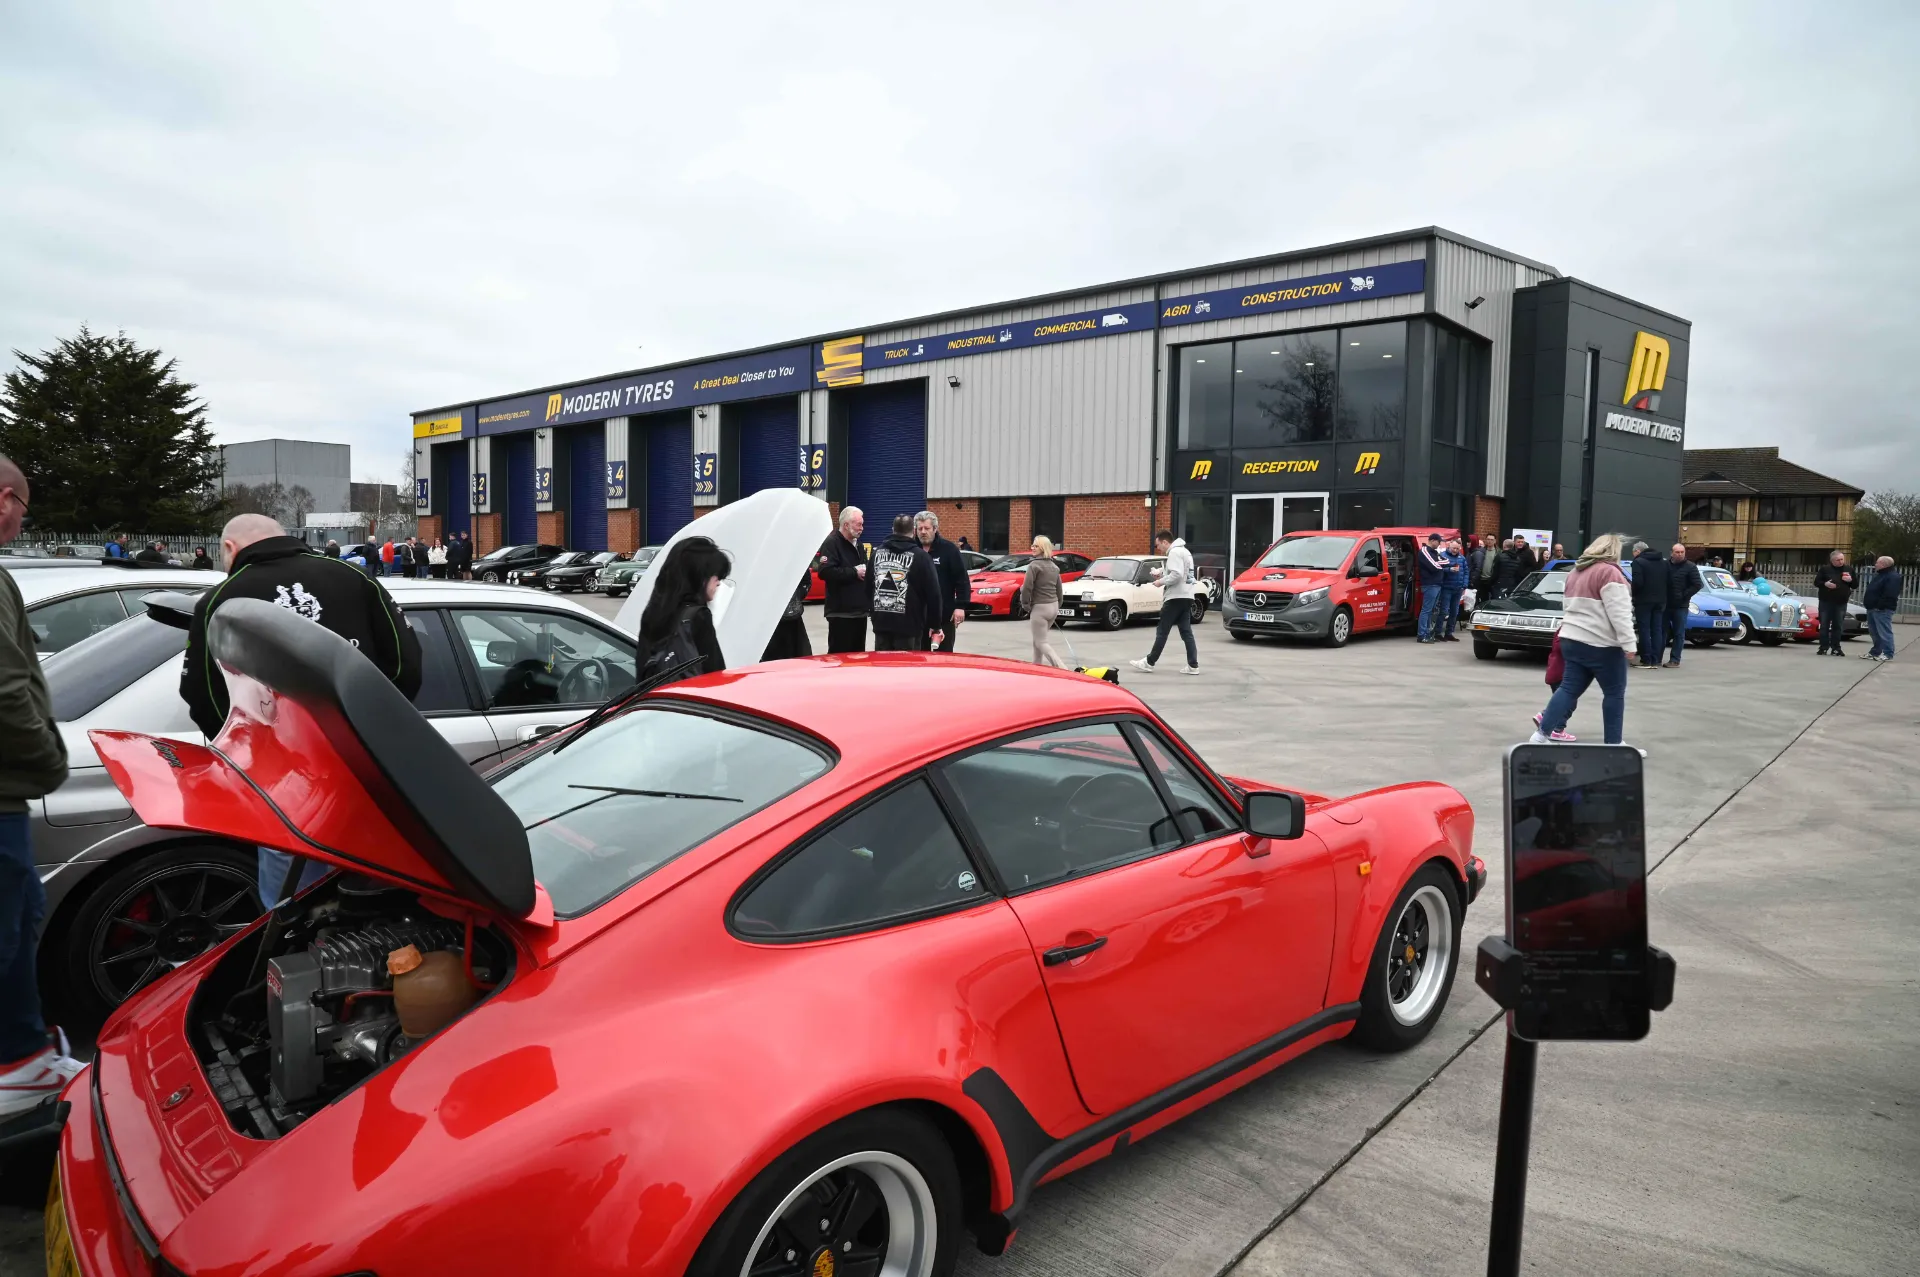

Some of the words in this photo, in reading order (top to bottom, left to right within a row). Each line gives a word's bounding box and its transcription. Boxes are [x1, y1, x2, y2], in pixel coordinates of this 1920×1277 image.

[1241, 282, 1342, 307] CONSTRUCTION
[1163, 304, 1191, 318] AGRI
[1034, 319, 1097, 337] COMMERCIAL
[947, 334, 996, 350] INDUSTRIAL
[884, 348, 908, 360] TRUCK
[694, 381, 699, 389] A
[701, 377, 721, 389] Great
[722, 374, 739, 386] Deal
[741, 369, 766, 383] Closer
[767, 369, 777, 379] to
[779, 366, 794, 378] You
[563, 389, 621, 415] MODERN
[625, 380, 674, 406] TYRES
[1605, 412, 1651, 436] MODERN
[1650, 421, 1682, 442] TYRES
[703, 458, 714, 476] 5
[811, 449, 824, 470] 6
[616, 465, 625, 480] 4
[1242, 460, 1320, 475] RECEPTION
[478, 477, 485, 491] 2
[542, 472, 550, 487] 3
[423, 482, 428, 495] 1
[1532, 619, 1547, 627] 744
